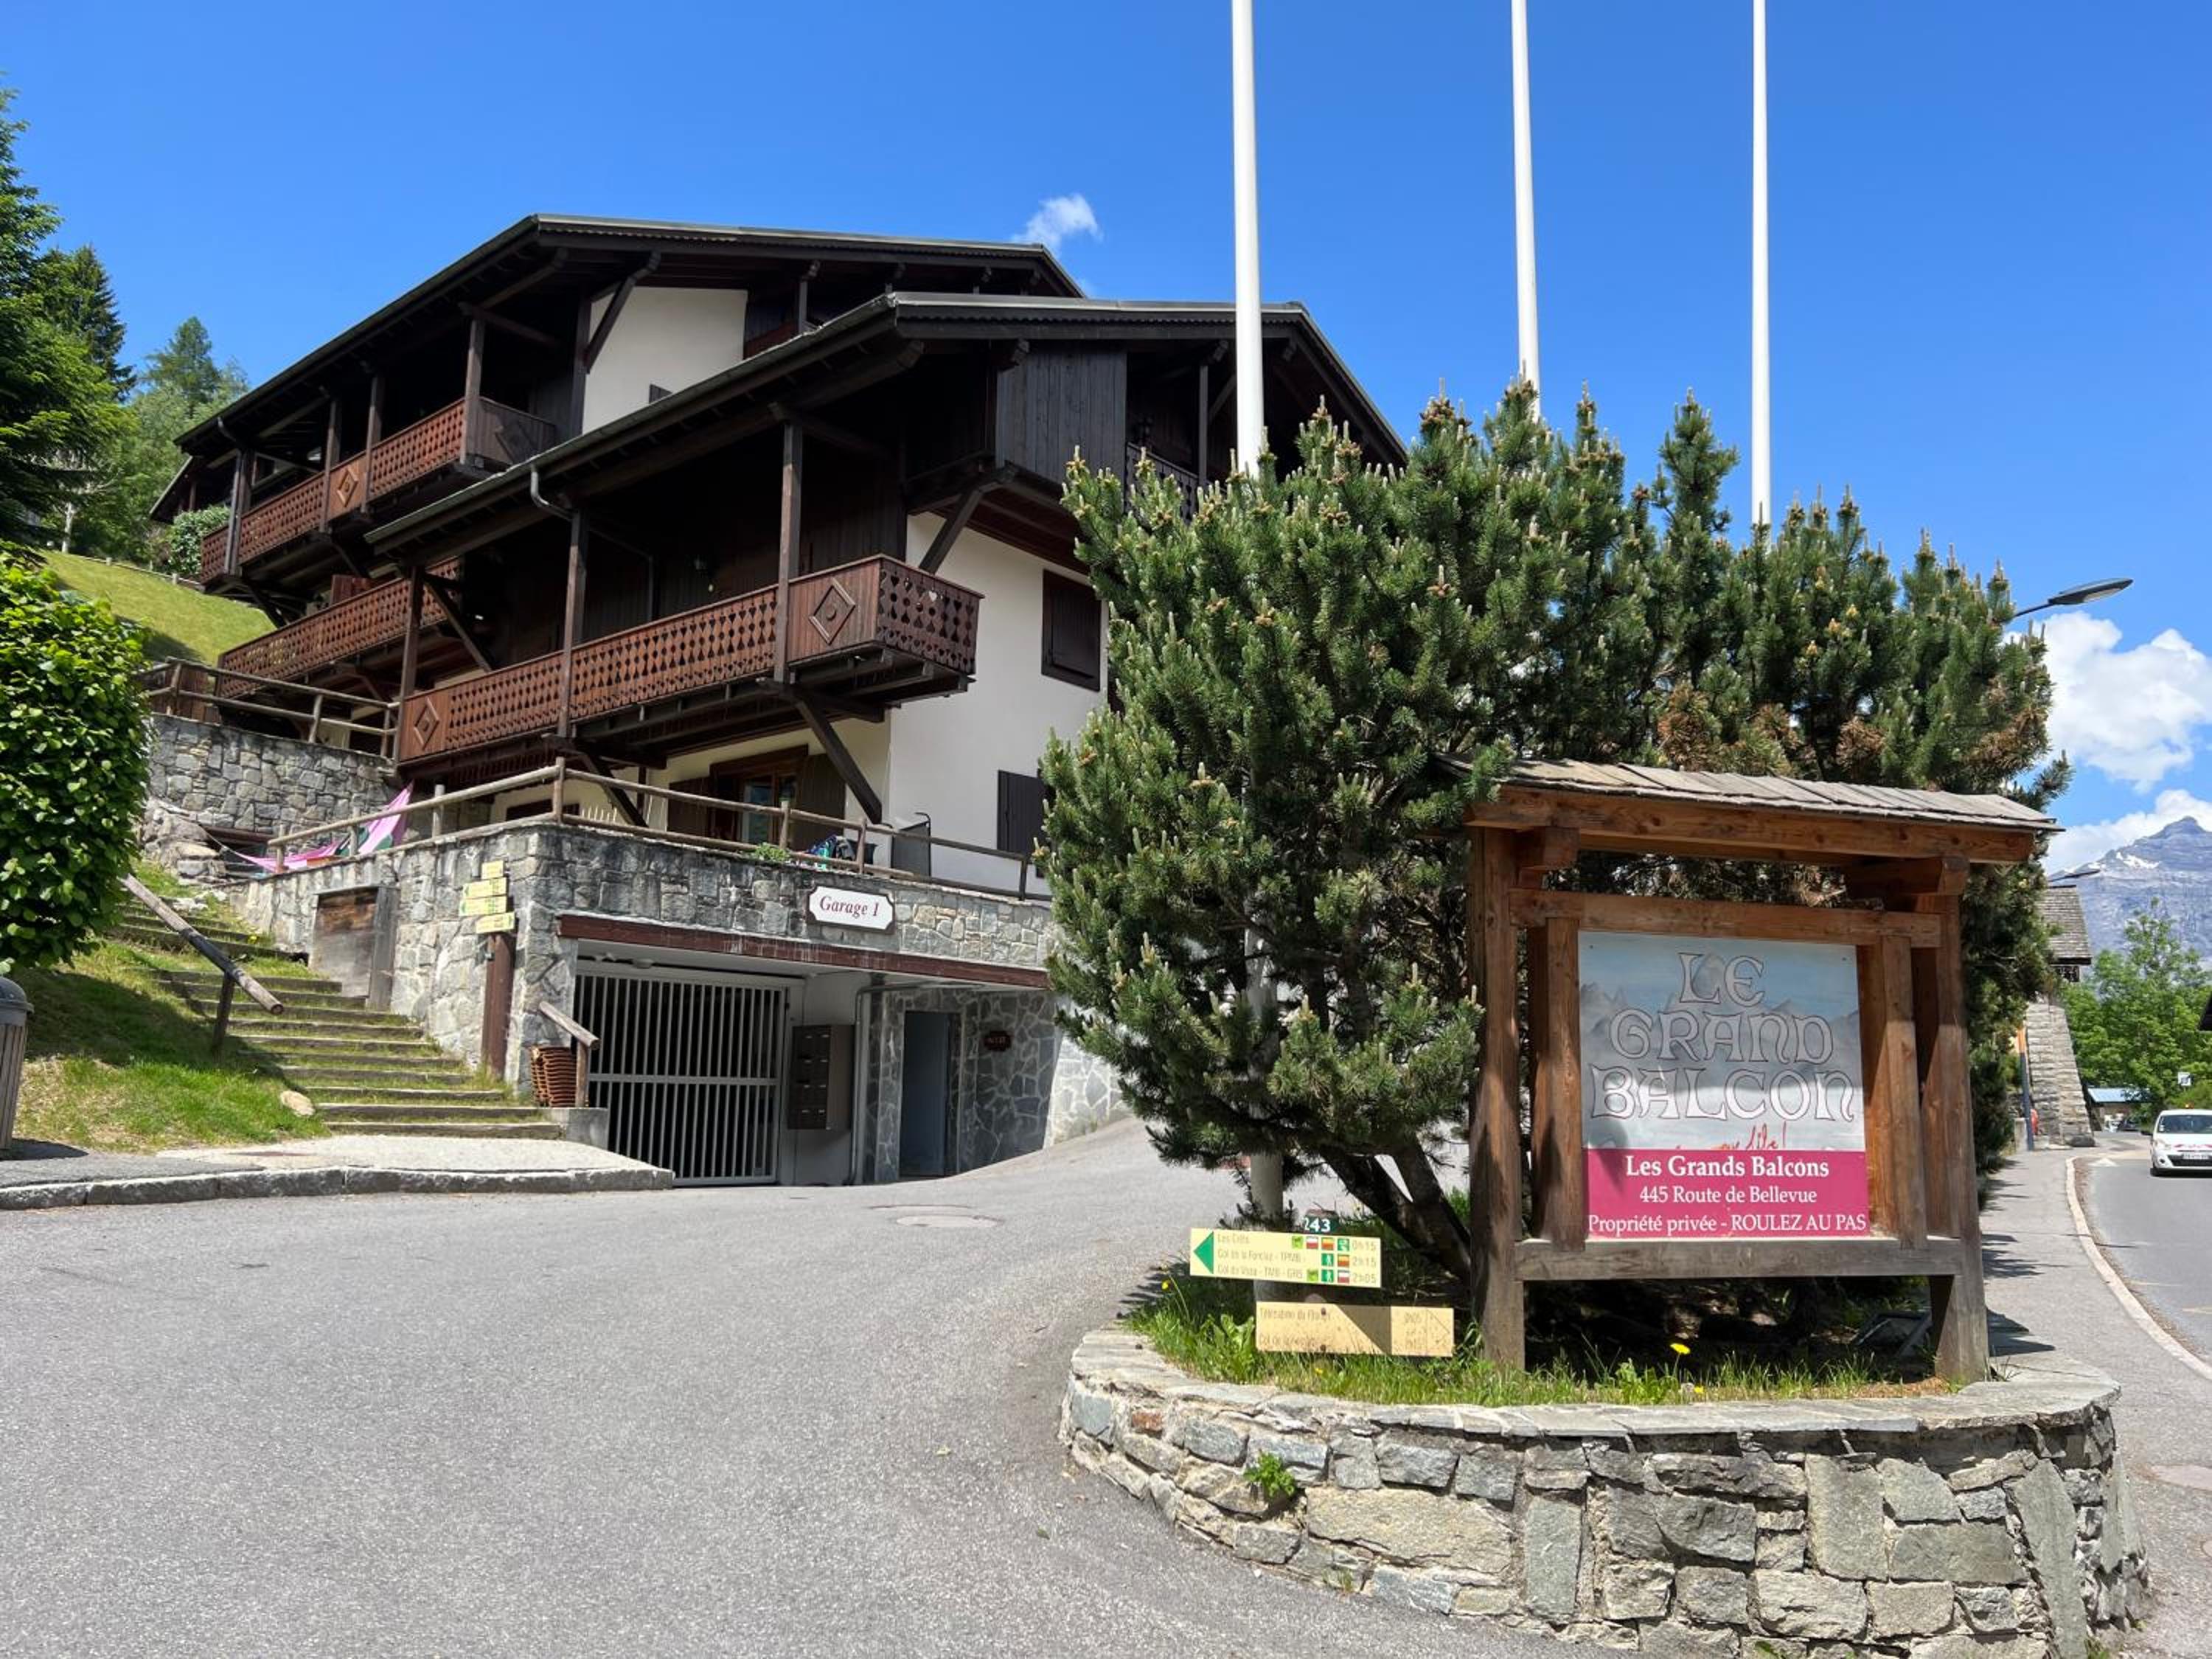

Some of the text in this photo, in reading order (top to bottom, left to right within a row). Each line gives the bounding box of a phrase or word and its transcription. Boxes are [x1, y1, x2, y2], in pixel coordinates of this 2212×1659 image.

[820, 895, 868, 919] Garage
[1678, 953, 1764, 1006] LE
[1610, 1009, 1834, 1065] GRAND
[1589, 1063, 1855, 1122] BALCON
[1626, 1155, 1829, 1178] Les Grands Balcons
[1639, 1185, 1818, 1203] 445 Route de Bellevue
[1304, 1217, 1331, 1232] 243
[1588, 1214, 1663, 1237] Propriété
[1666, 1214, 1717, 1237] privée
[1731, 1214, 1802, 1231] ROULEZ
[1804, 1214, 1832, 1231] AU
[1835, 1214, 1867, 1231] PAS
[1217, 1249, 1228, 1259] Col
[1217, 1265, 1228, 1274] Col
